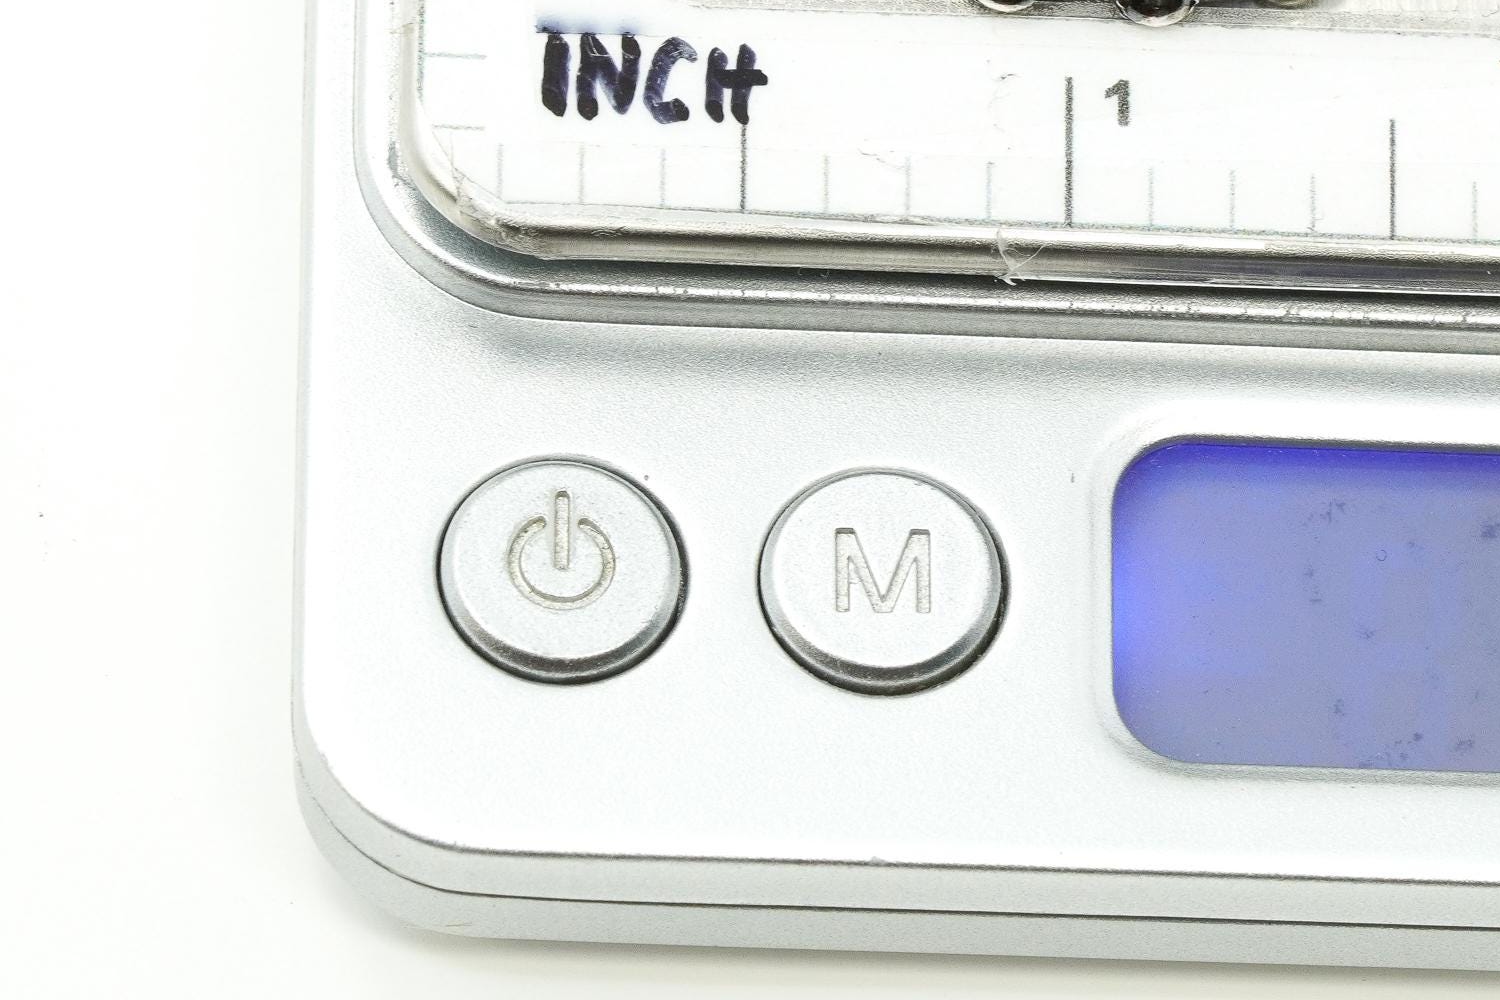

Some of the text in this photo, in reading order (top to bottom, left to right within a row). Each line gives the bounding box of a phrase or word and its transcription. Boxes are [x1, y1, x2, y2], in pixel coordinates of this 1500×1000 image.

[540, 31, 769, 125] INCH
[1105, 79, 1132, 127] 1
[833, 527, 932, 614] M
